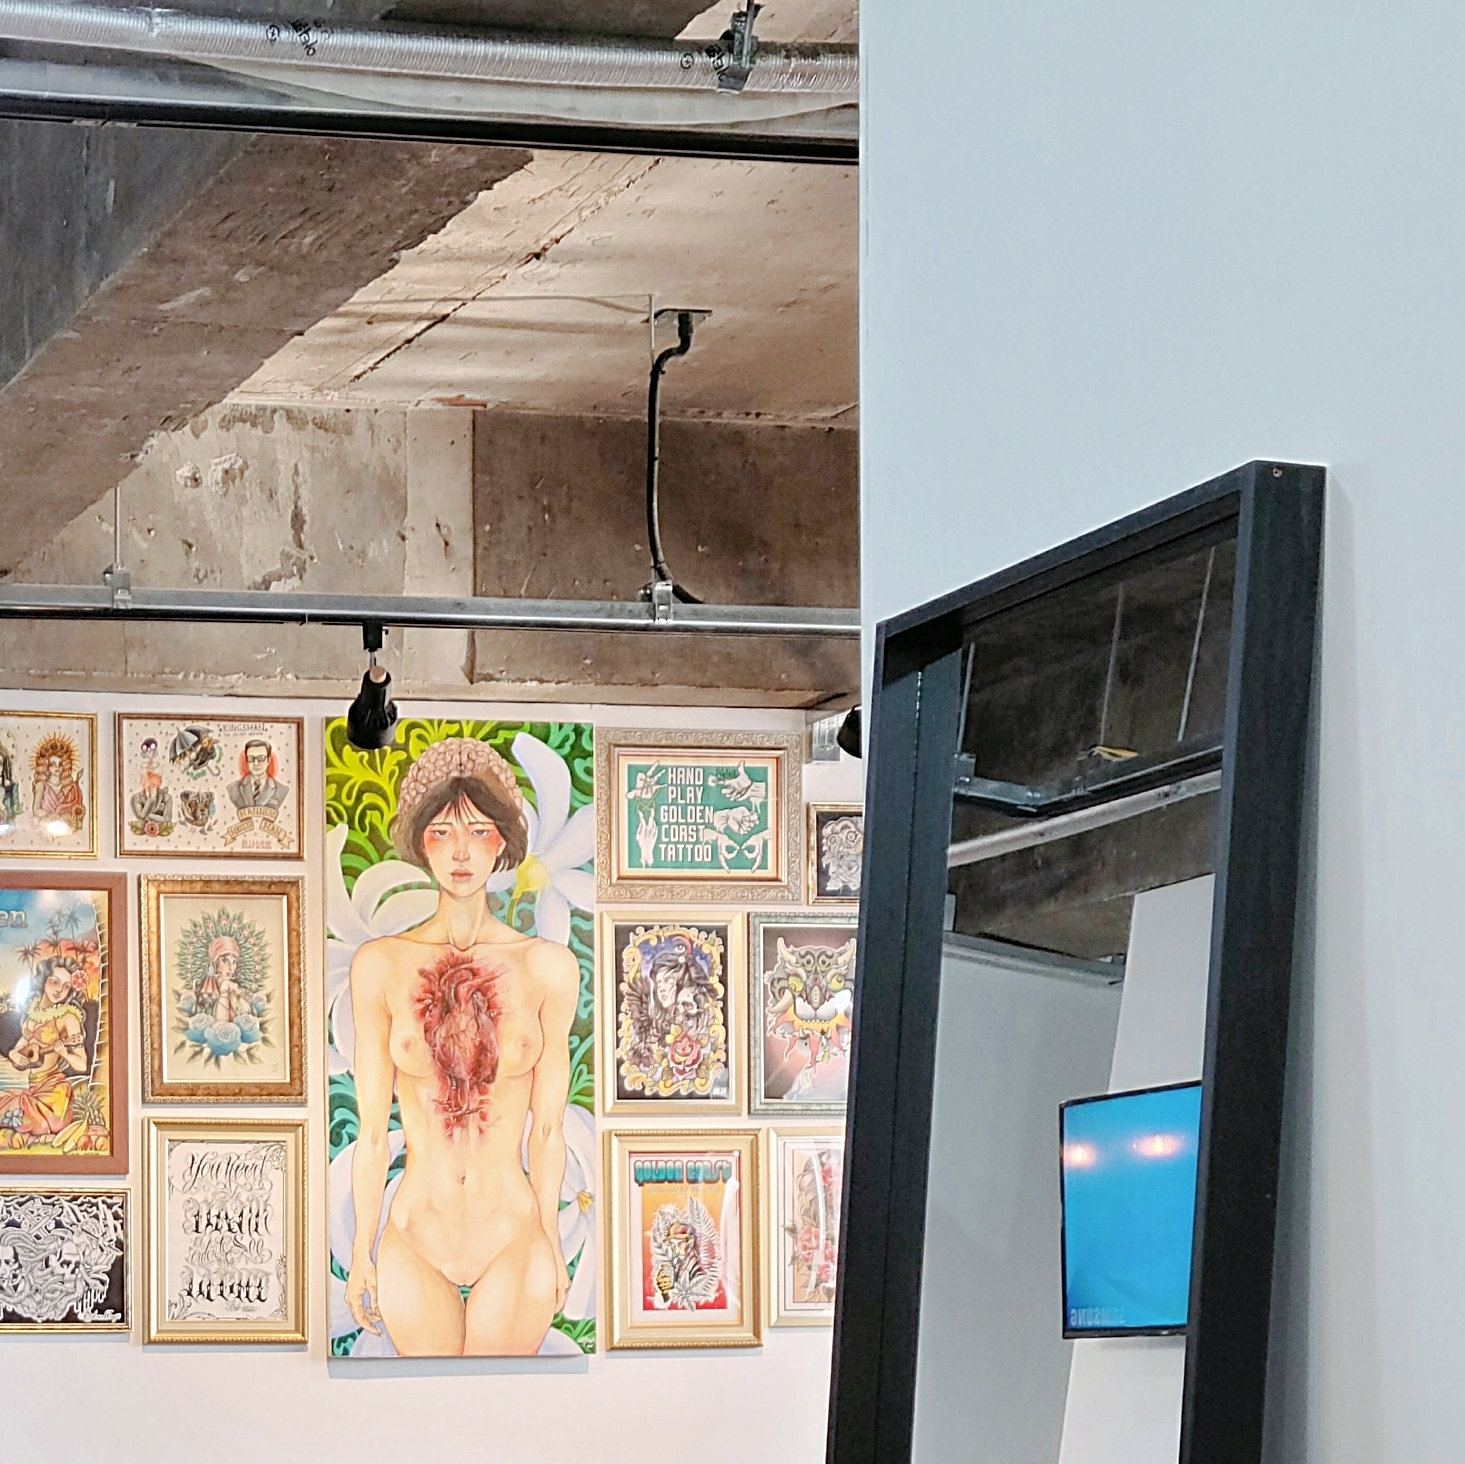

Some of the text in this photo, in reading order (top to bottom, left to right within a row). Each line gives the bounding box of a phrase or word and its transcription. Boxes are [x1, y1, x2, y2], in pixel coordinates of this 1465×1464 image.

[223, 723, 265, 732] KINGSMAN
[668, 767, 704, 785] HAND
[668, 786, 704, 804] PLAY
[660, 805, 714, 823] GOLDEN
[661, 825, 706, 842] COAST
[658, 844, 712, 862] TATTOO
